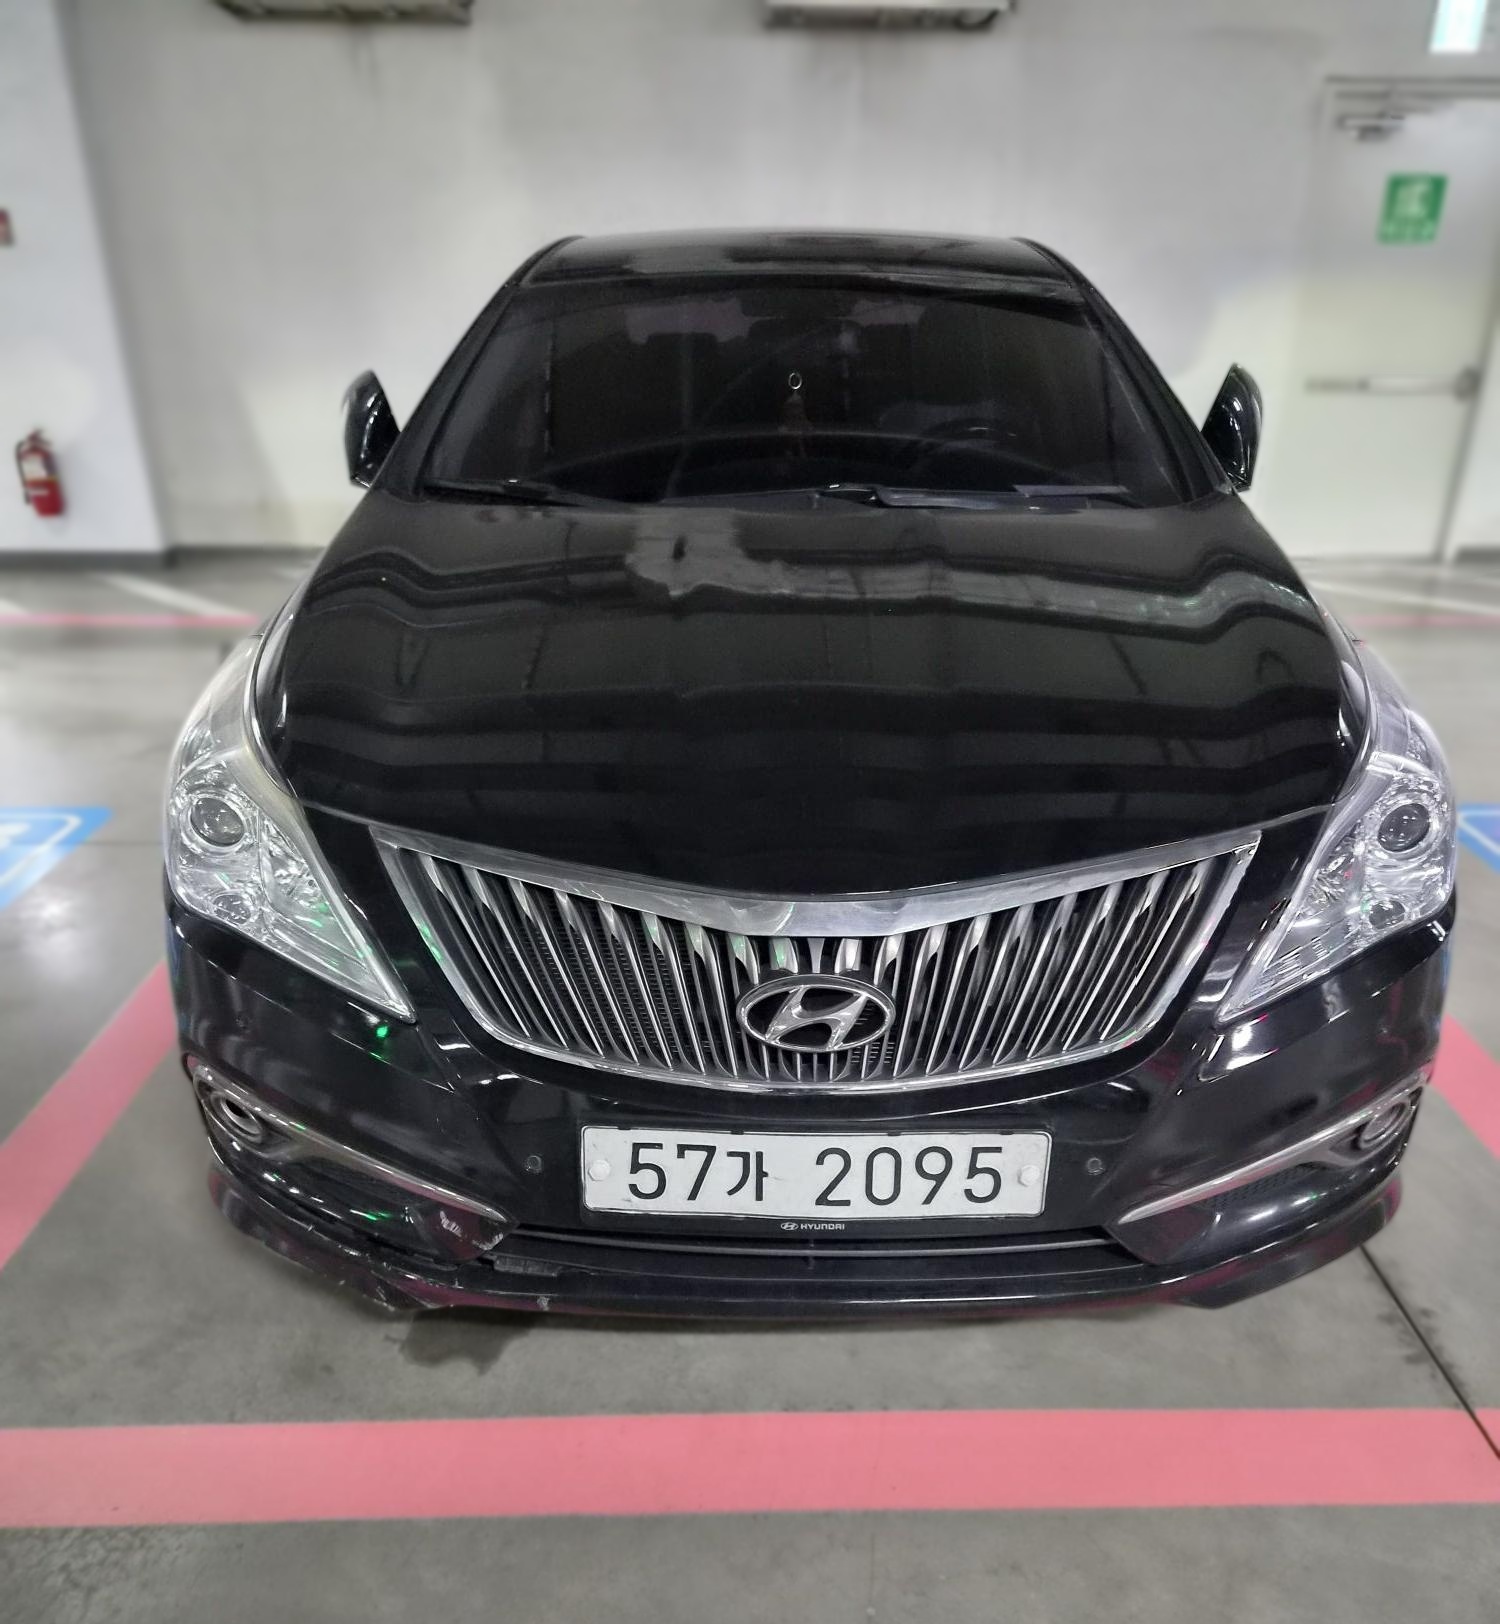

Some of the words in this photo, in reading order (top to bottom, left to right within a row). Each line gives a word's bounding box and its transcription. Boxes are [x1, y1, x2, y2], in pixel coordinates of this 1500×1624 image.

[628, 1142, 769, 1202] 57가
[814, 1145, 1003, 1207] 2095
[800, 1223, 845, 1231] HYUNDAI
